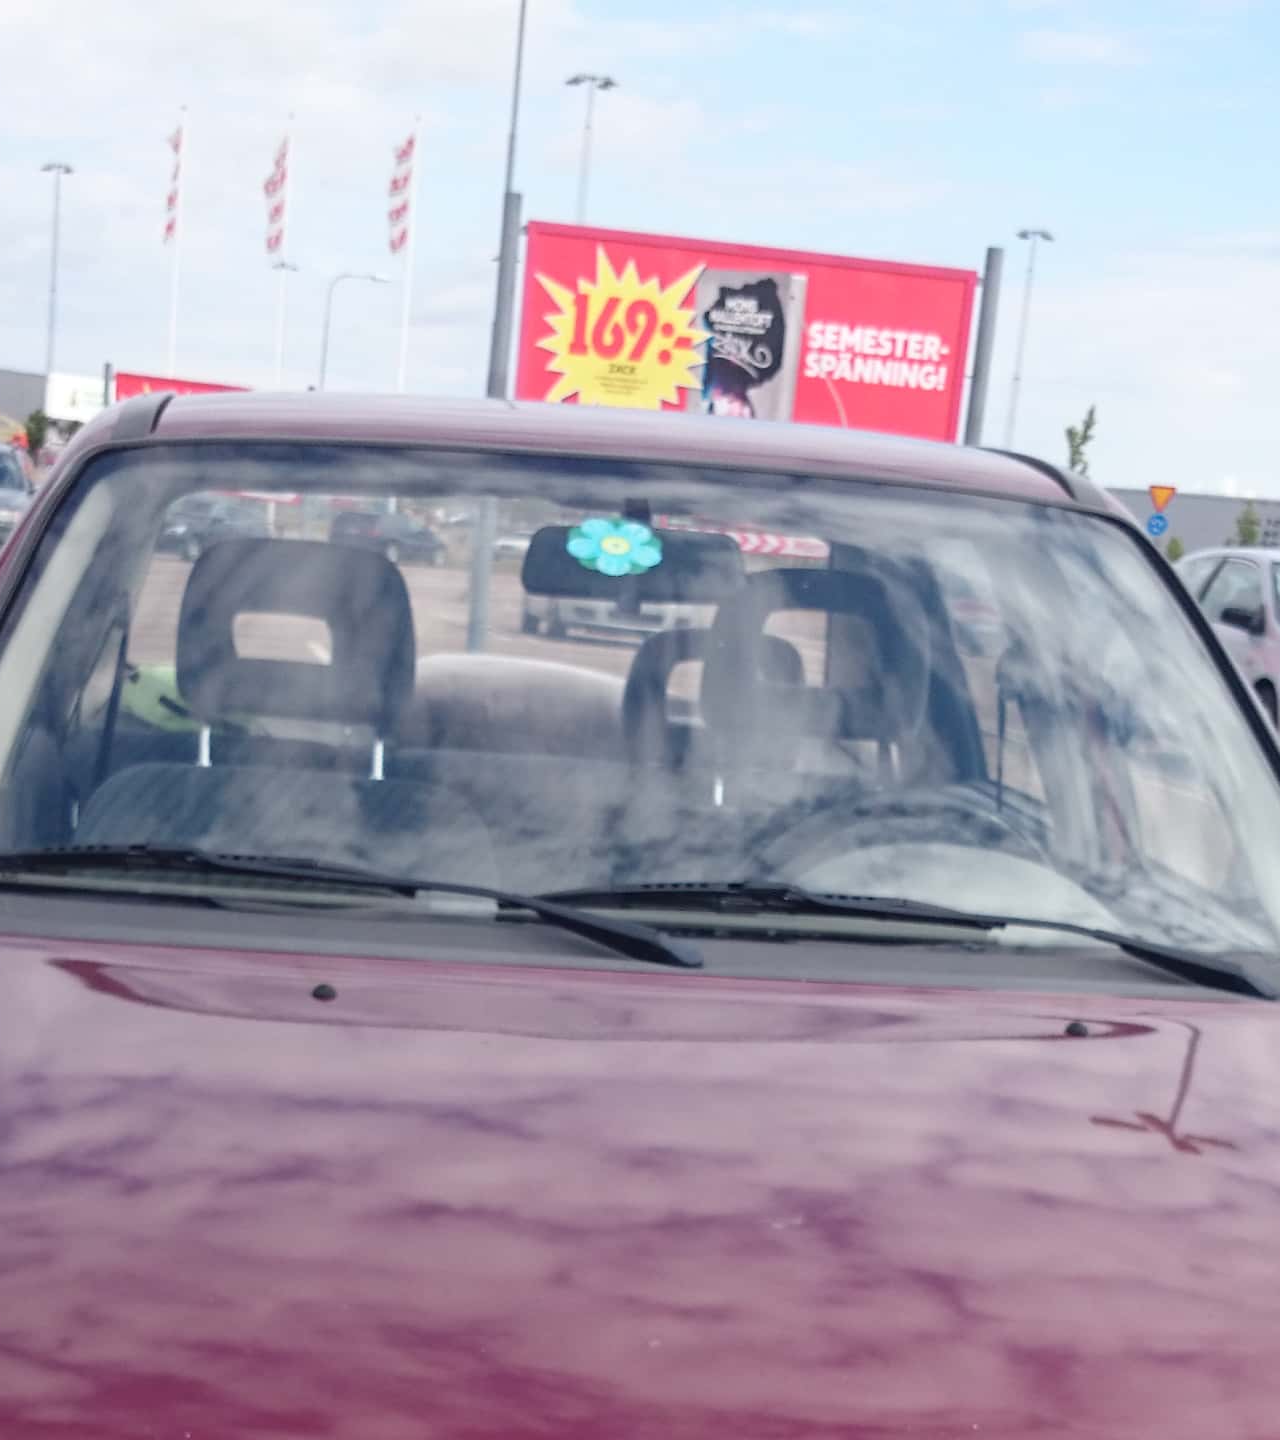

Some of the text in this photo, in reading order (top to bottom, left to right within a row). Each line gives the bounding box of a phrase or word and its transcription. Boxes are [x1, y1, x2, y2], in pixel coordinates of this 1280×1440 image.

[568, 293, 693, 366] 169:-
[808, 321, 950, 361] SEMESTER-
[804, 351, 948, 391] SPÄNNING!
